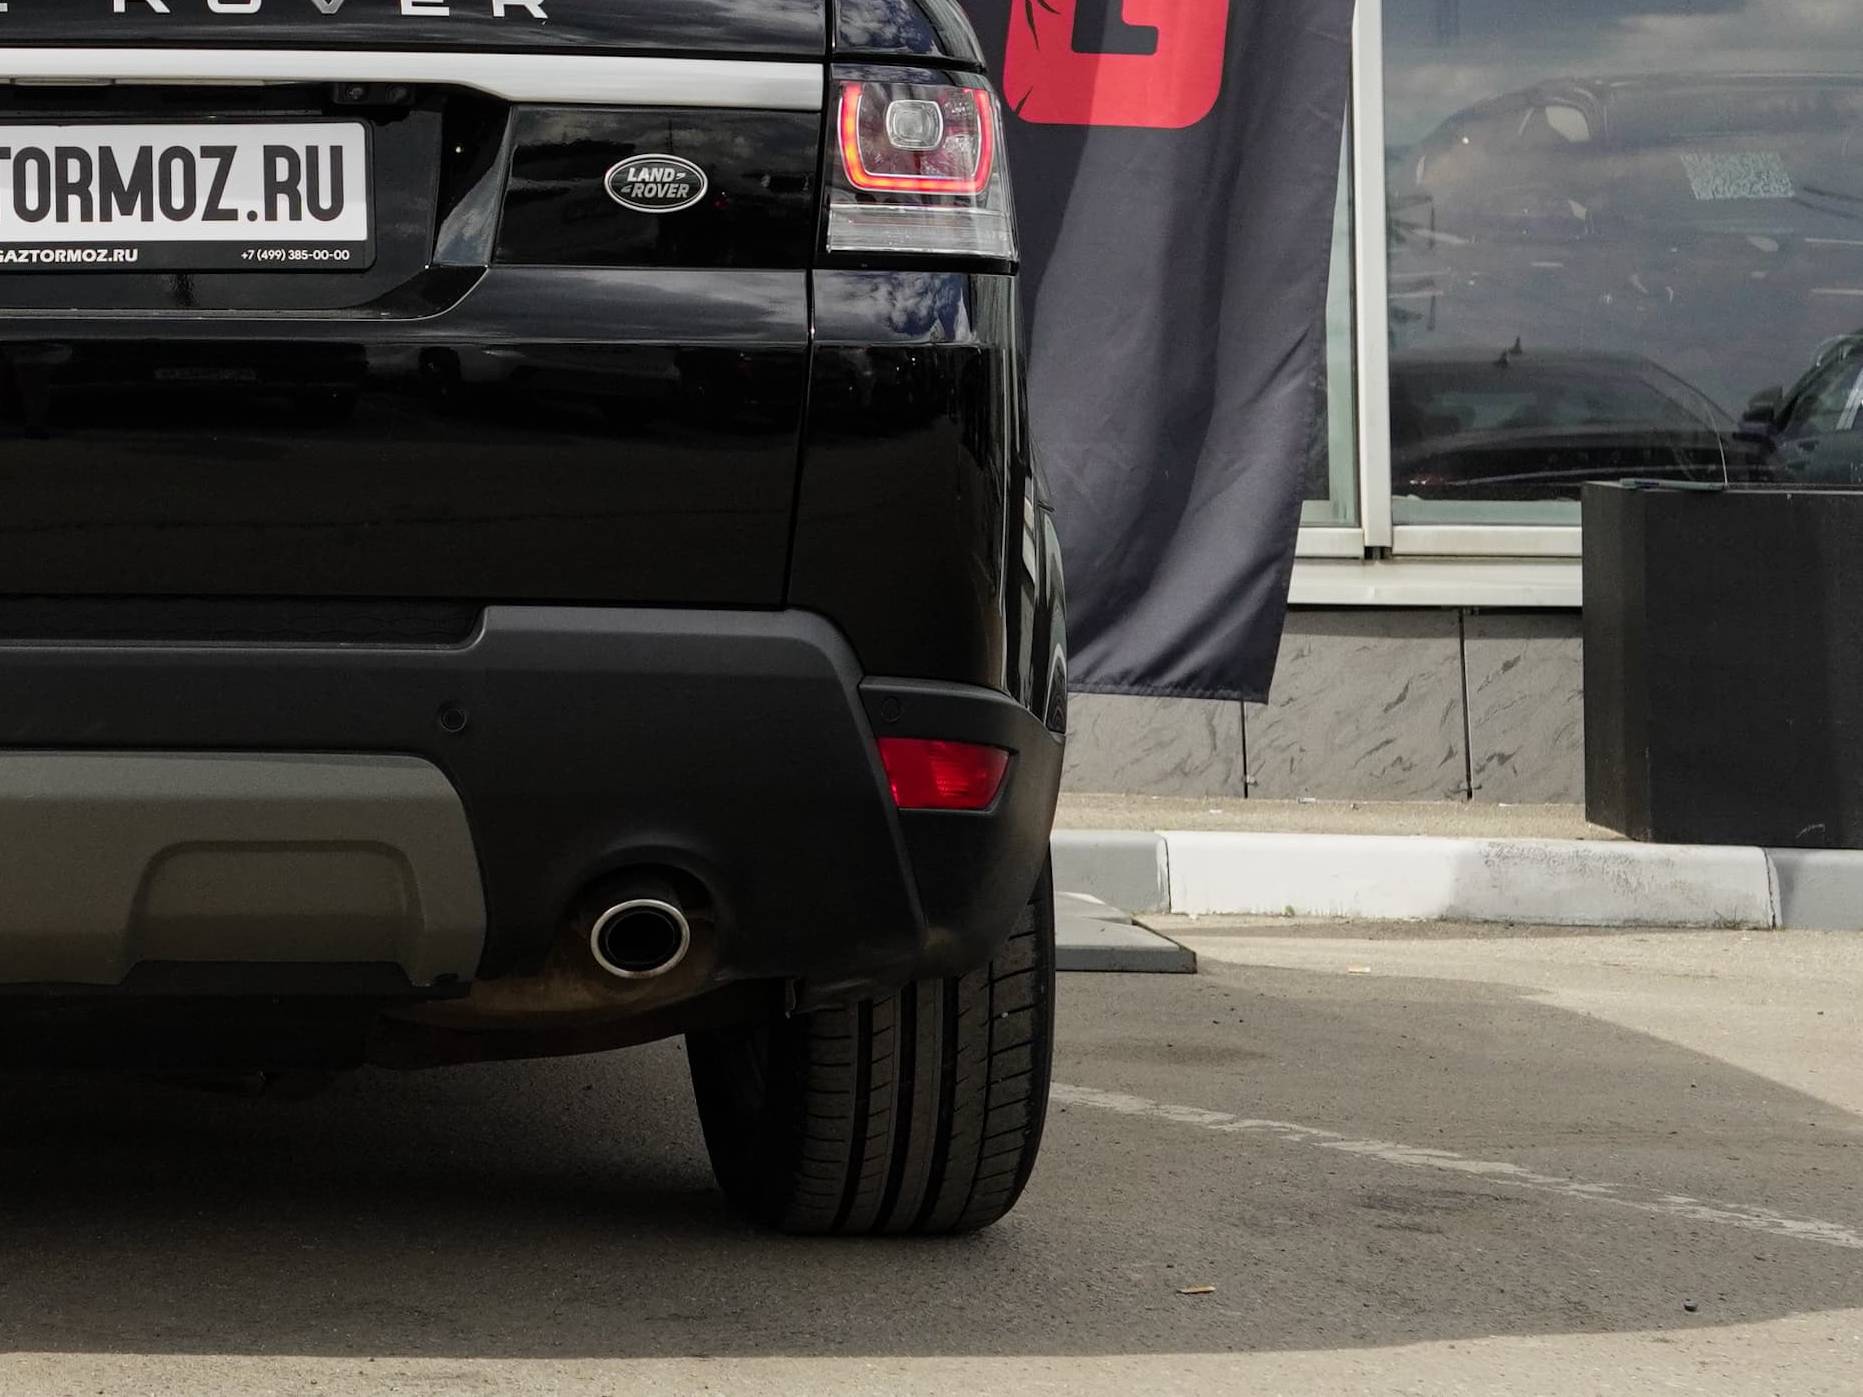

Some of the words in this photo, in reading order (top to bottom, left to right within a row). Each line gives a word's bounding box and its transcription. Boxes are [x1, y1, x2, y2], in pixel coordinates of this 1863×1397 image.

[626, 166, 676, 183] LAND
[630, 183, 691, 199] ROVER
[240, 250, 255, 261] +7
[256, 248, 287, 262] (499)
[287, 249, 350, 261] 385-00-00
